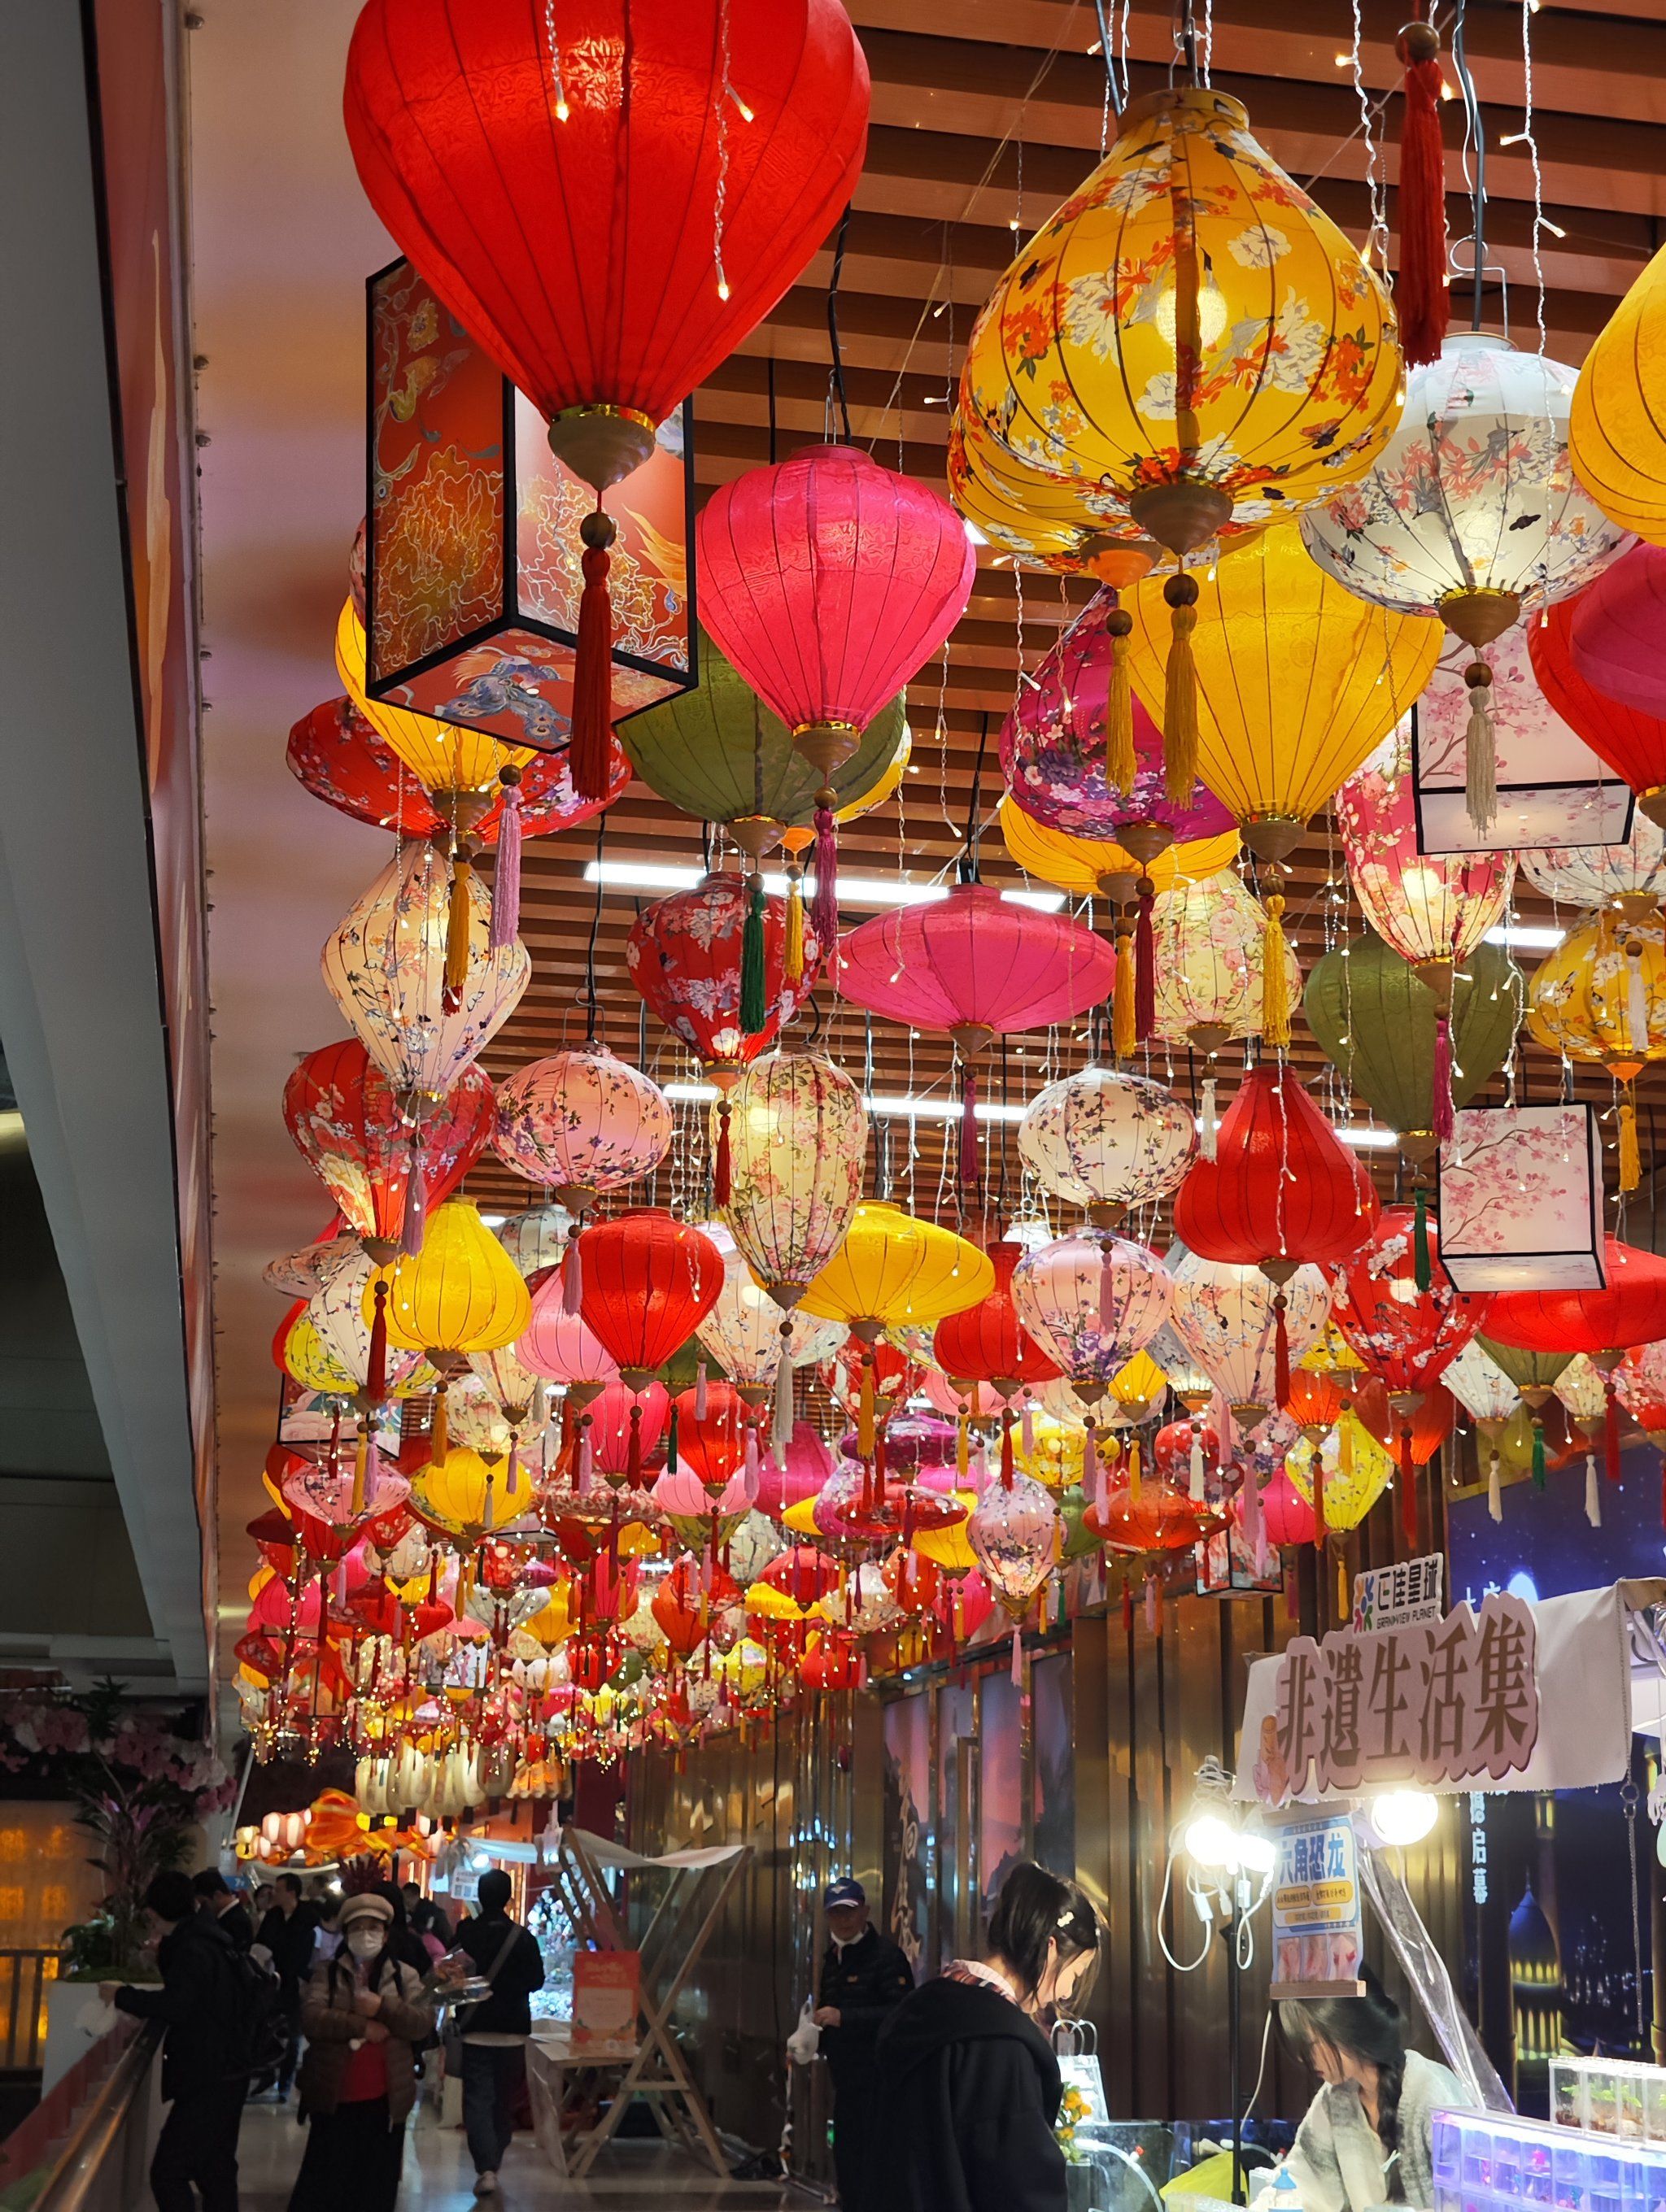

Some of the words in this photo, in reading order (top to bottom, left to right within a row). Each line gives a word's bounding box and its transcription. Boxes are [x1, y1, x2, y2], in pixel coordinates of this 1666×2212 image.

[1378, 1559, 1438, 1611] 正佳星球
[1412, 1605, 1436, 1622] PLANET
[1279, 1832, 1346, 1885] 六角恐龙
